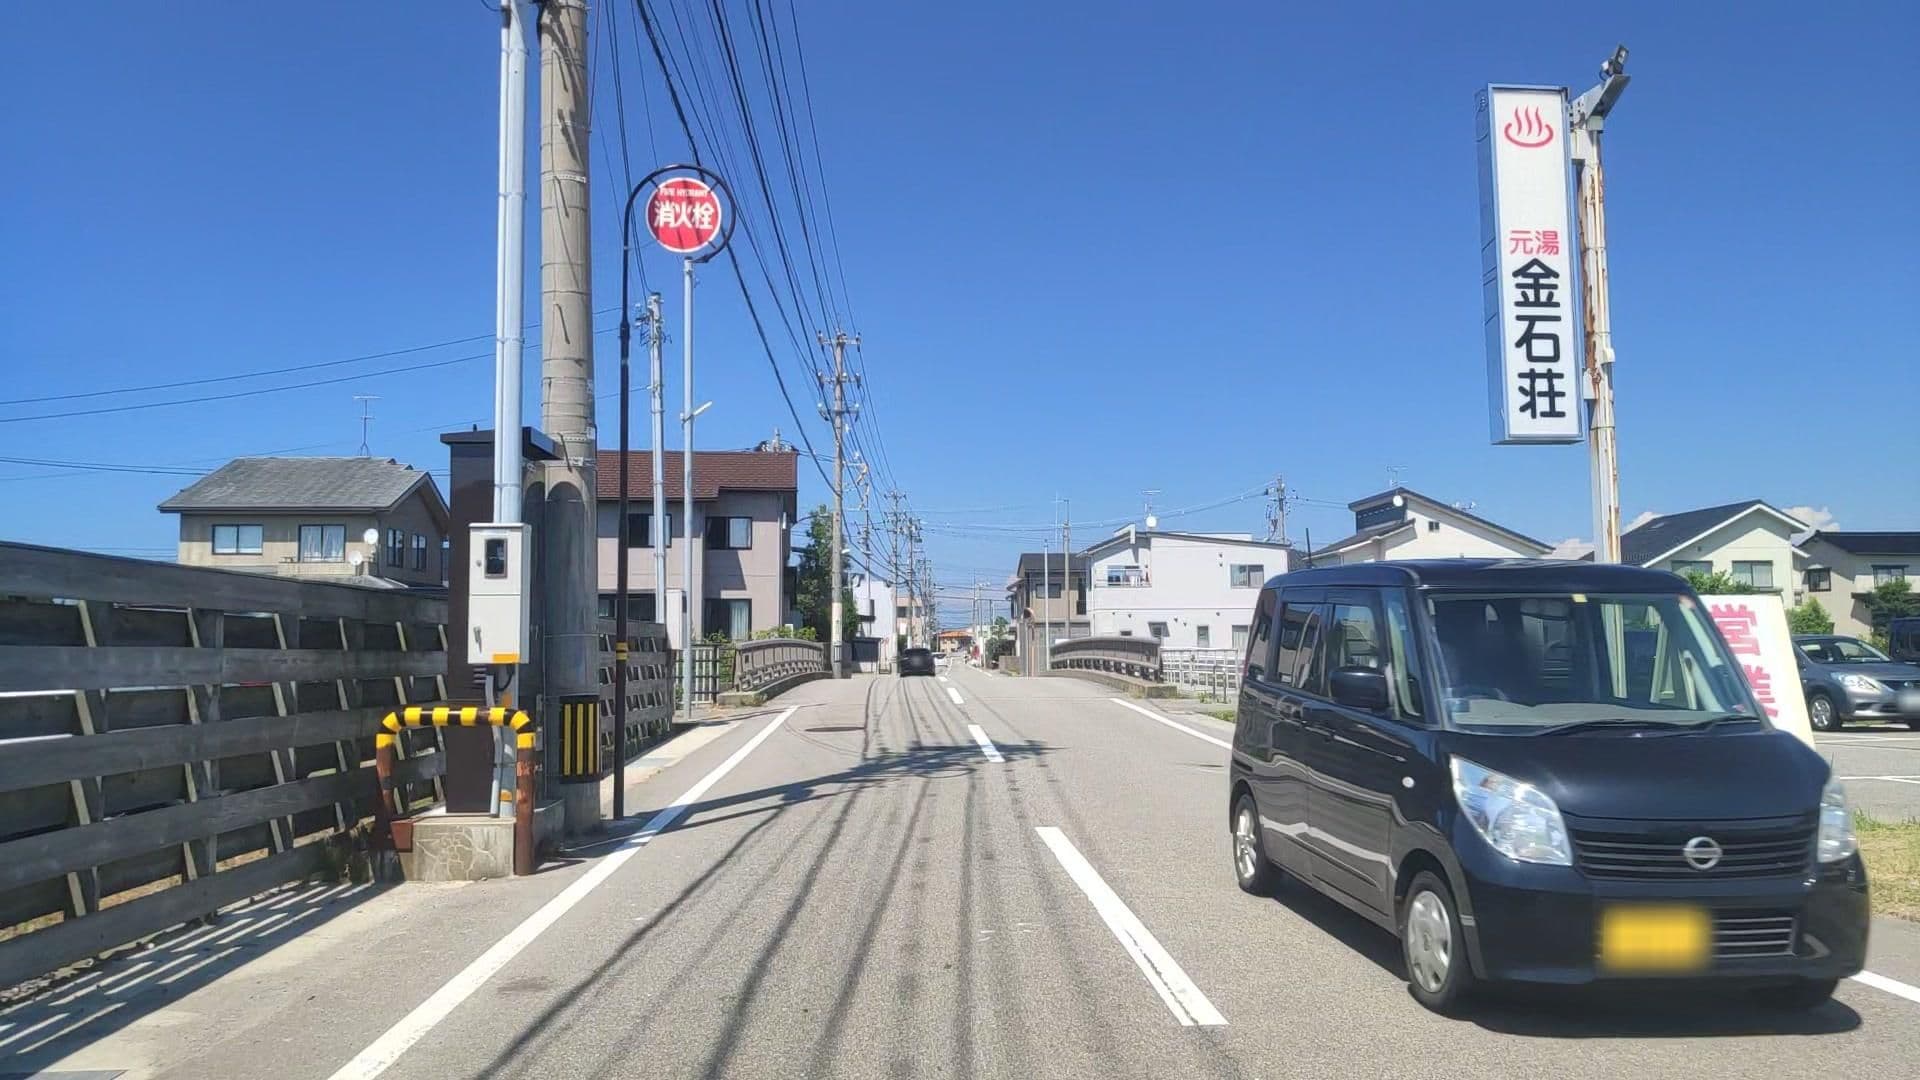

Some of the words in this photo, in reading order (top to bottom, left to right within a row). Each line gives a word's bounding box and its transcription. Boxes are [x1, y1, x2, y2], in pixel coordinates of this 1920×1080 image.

[653, 199, 715, 230] 消火栓
[1509, 230, 1560, 256] 元湯
[1511, 257, 1567, 420] 金石荘
